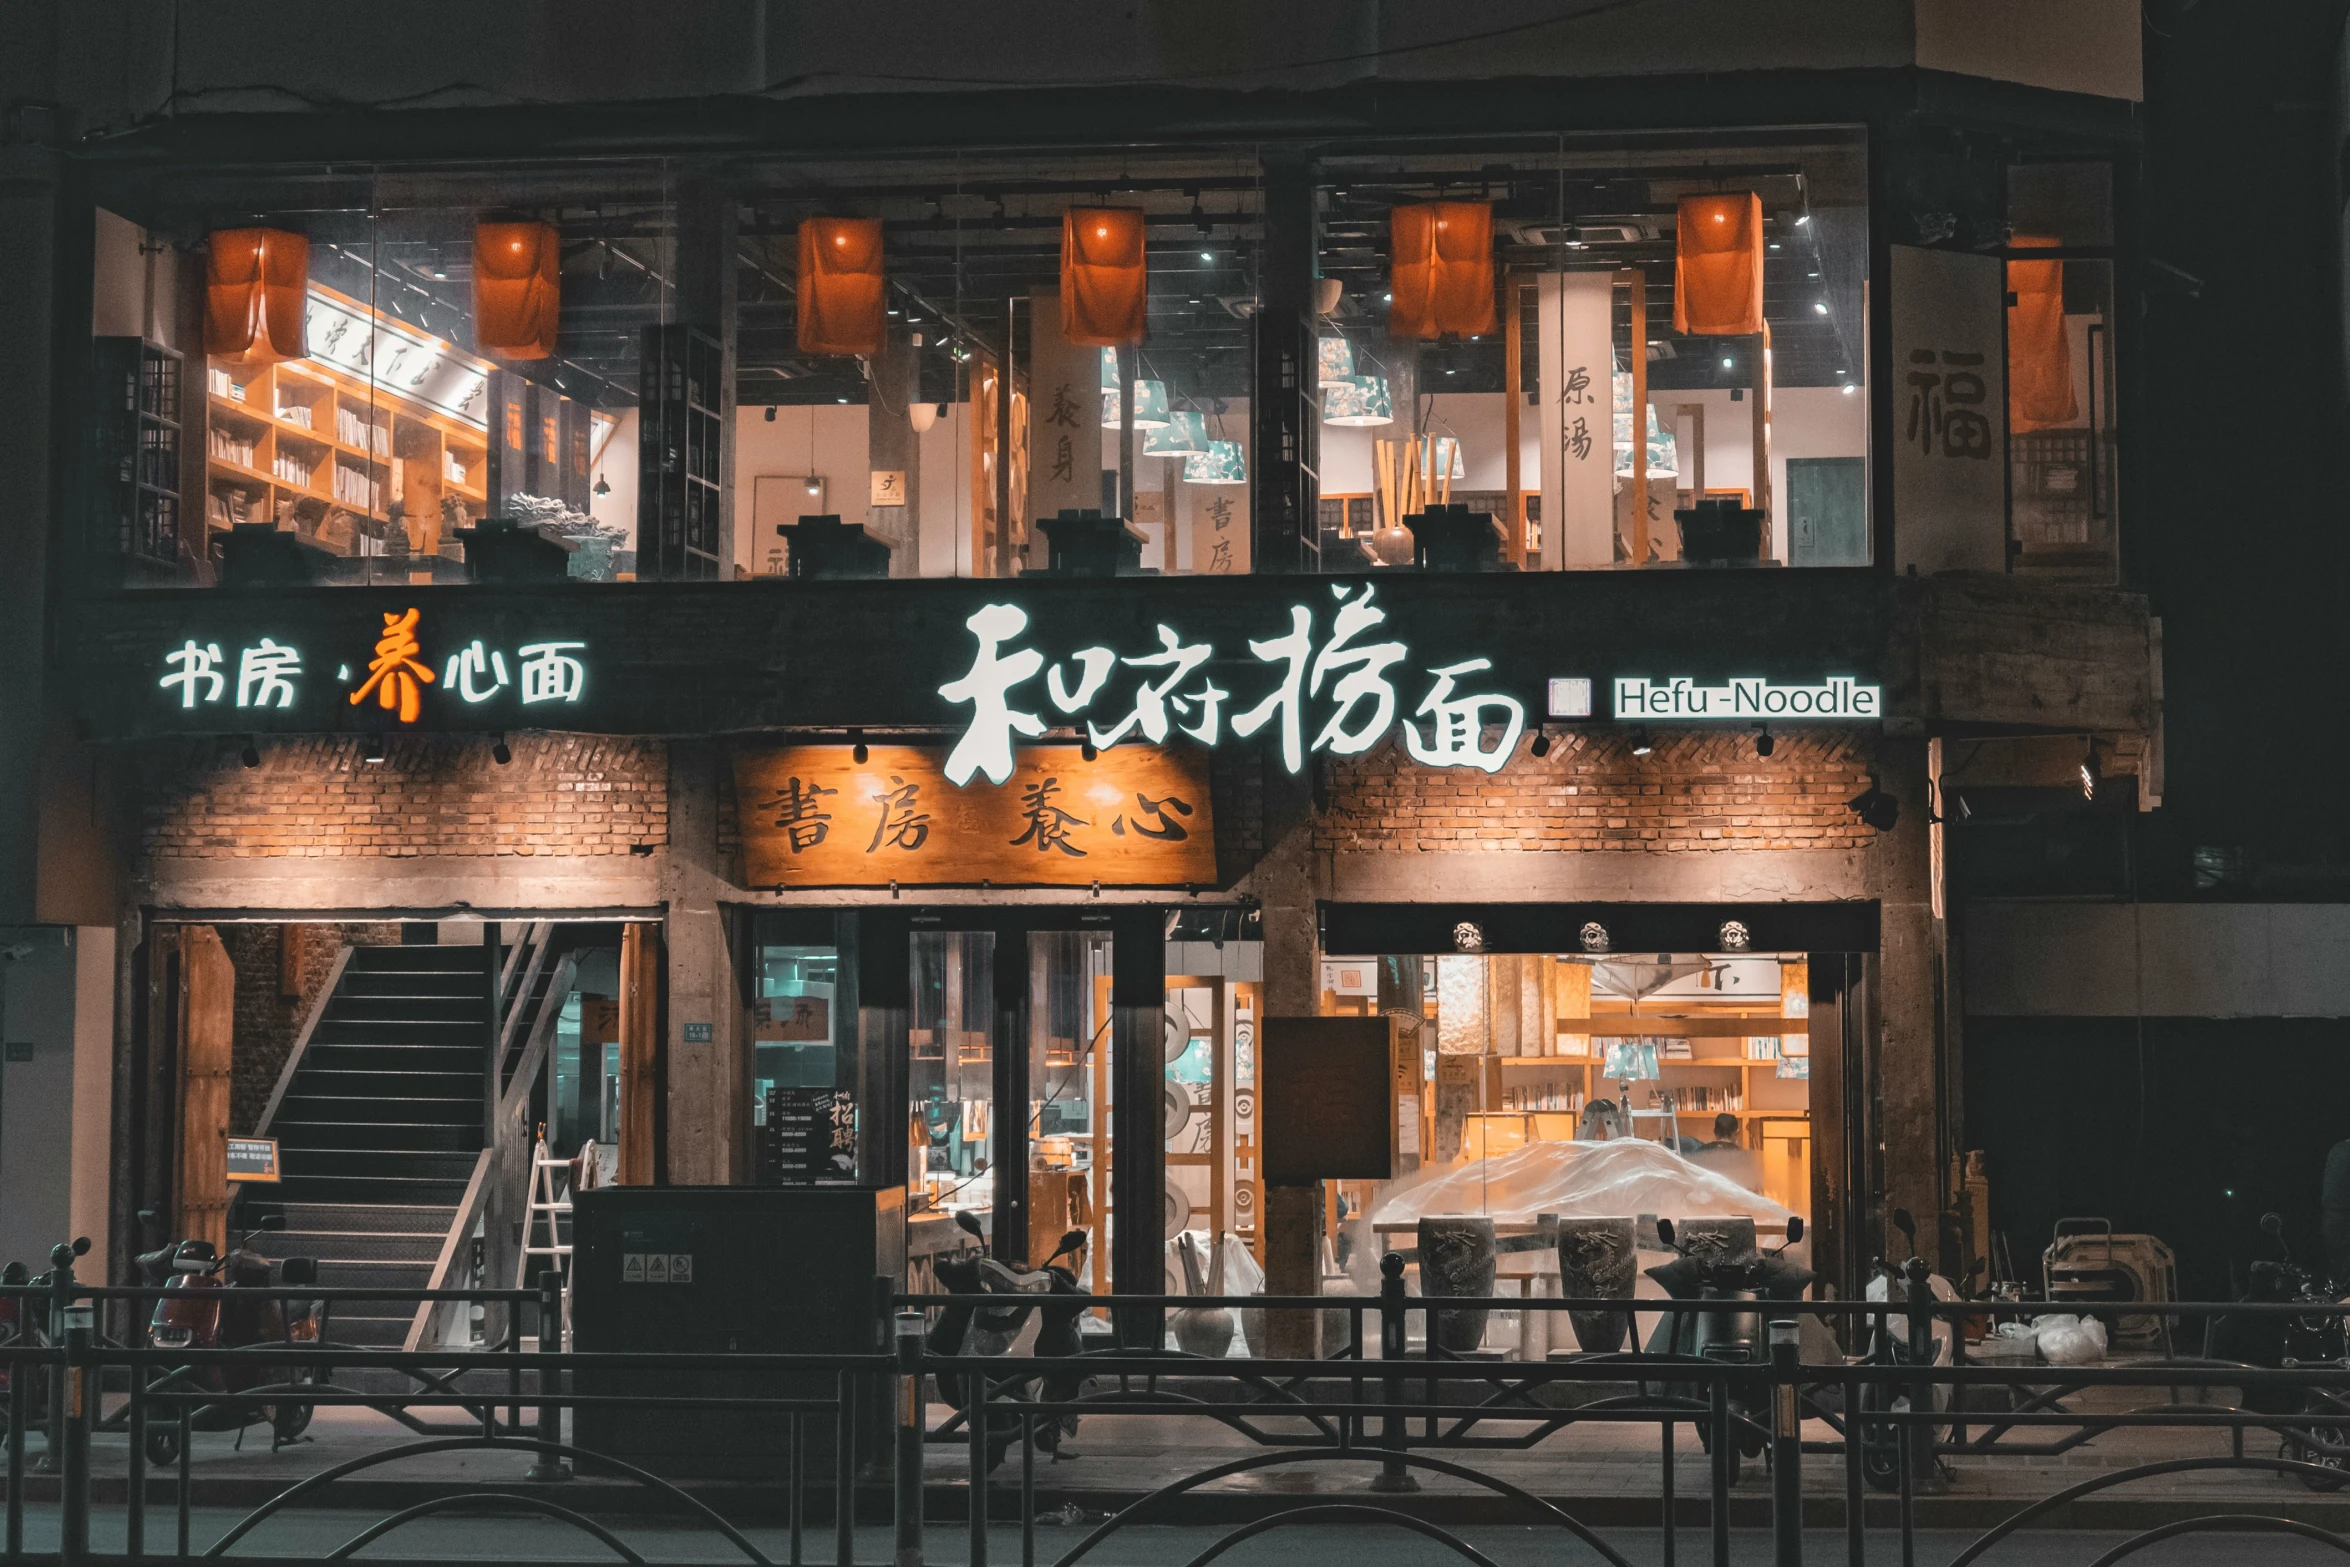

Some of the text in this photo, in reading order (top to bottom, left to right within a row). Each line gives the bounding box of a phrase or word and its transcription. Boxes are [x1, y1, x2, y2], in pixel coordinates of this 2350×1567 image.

[1045, 383, 1081, 483] 養身
[1555, 366, 1595, 461] 原湯
[1906, 349, 1991, 460] 福
[1206, 496, 1235, 572] 書房
[938, 582, 1524, 787] 和府捞面
[829, 1101, 855, 1152] 招聘
